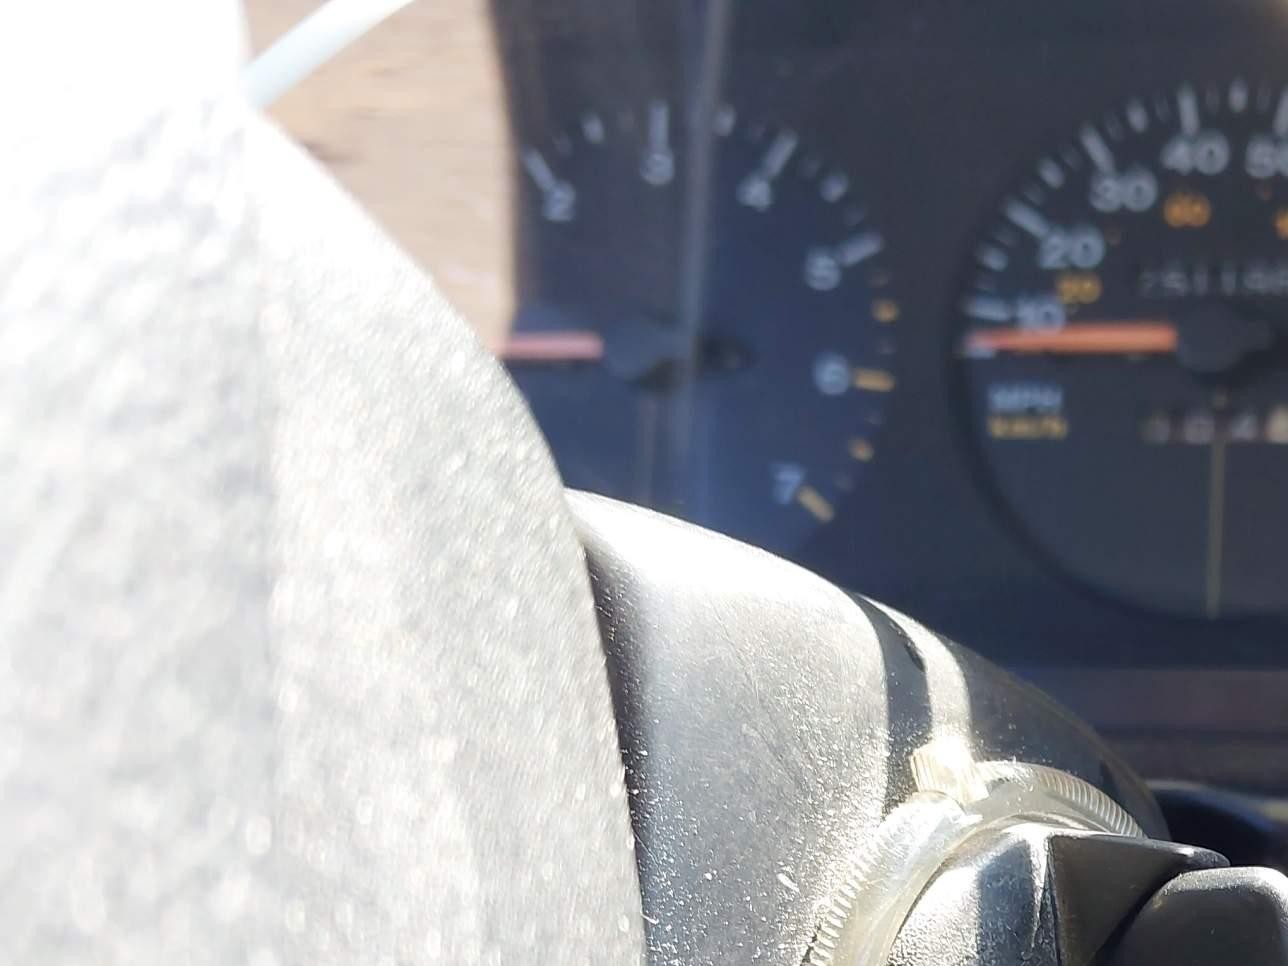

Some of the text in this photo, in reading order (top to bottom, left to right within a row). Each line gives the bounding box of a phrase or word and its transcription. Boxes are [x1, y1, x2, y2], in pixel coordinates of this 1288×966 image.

[641, 152, 674, 184] 3
[1162, 130, 1229, 175] 40
[543, 180, 576, 221] 2
[738, 177, 772, 212] 4
[1091, 171, 1157, 212] 30
[1039, 225, 1103, 269] 20
[806, 248, 840, 290] 5
[1016, 296, 1066, 333] 10
[815, 353, 849, 395] 6
[774, 463, 804, 504] 7
